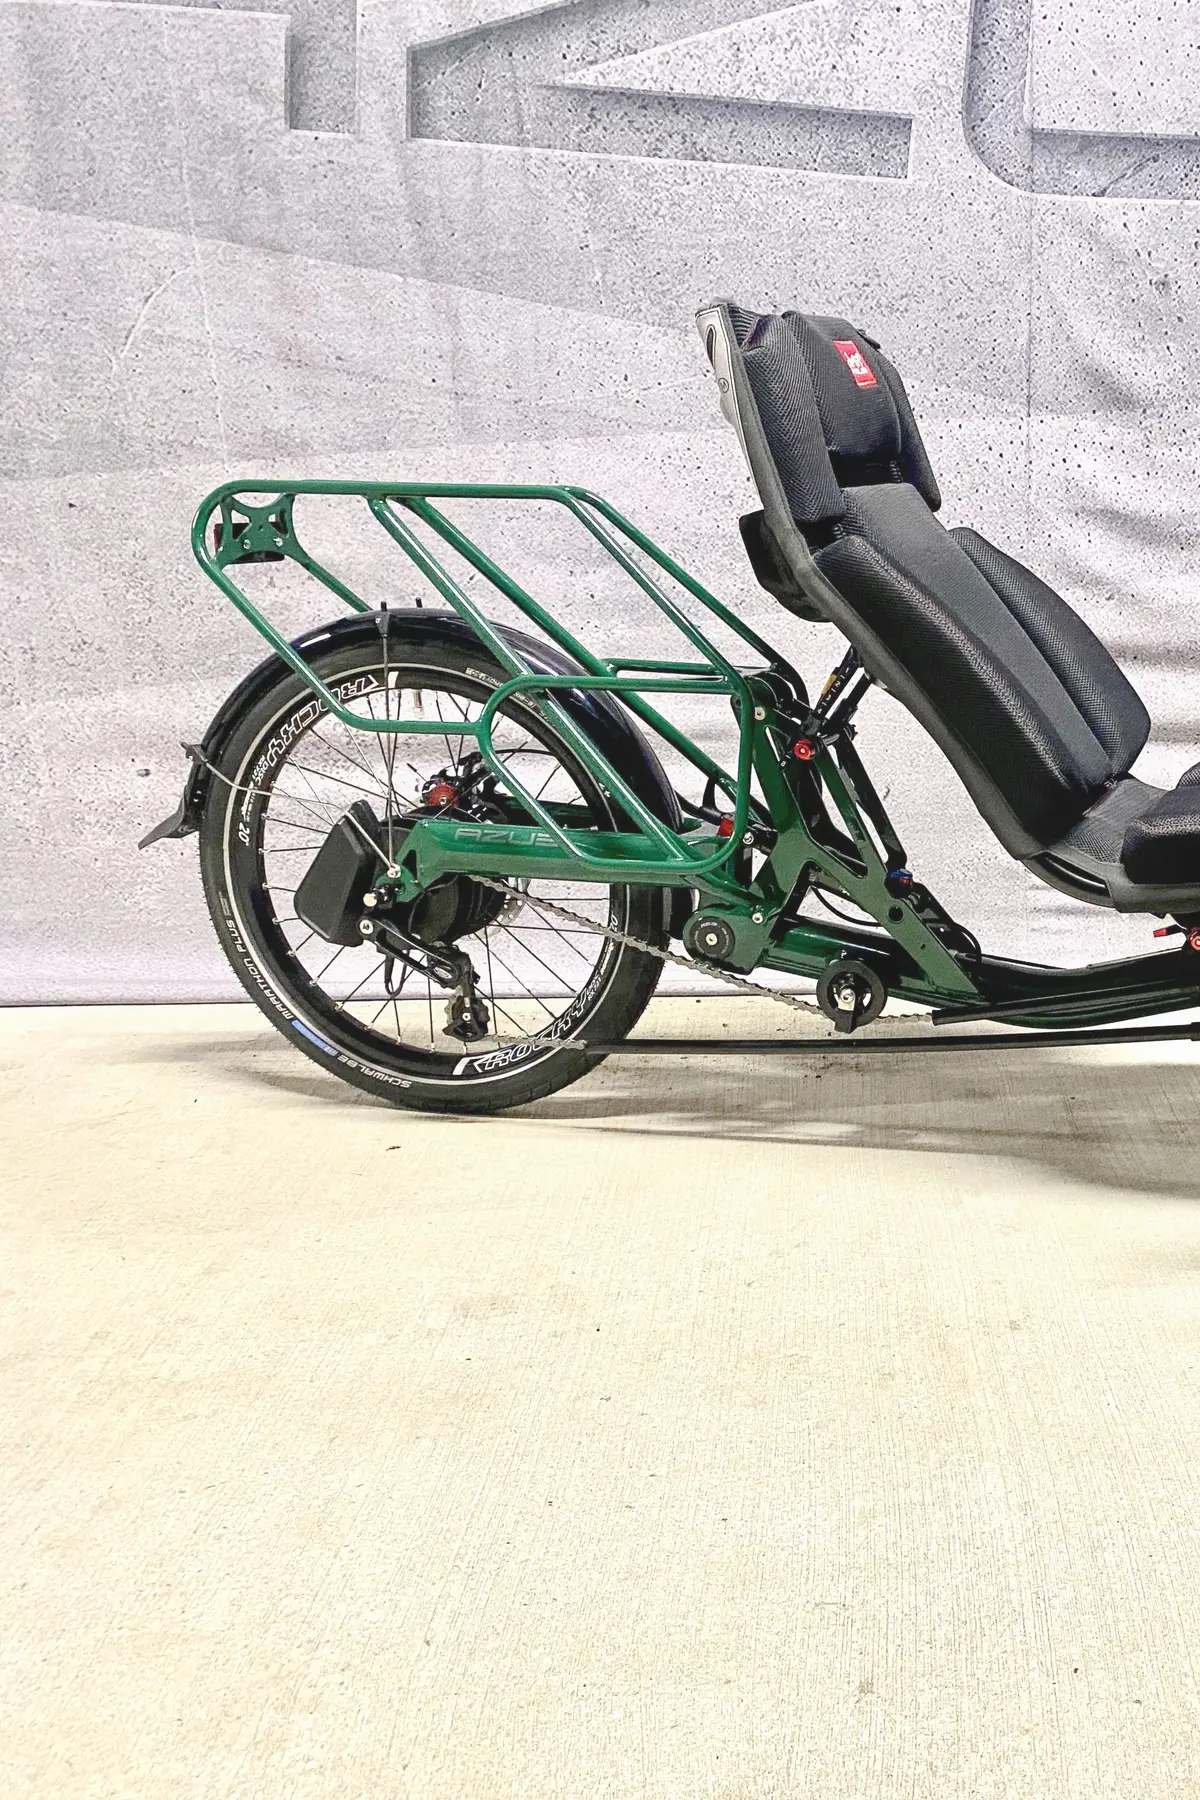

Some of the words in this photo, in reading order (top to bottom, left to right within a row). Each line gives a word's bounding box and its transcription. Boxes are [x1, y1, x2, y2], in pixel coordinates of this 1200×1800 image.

[225, 918, 247, 954] PLUS
[243, 956, 295, 1021] MARATHON
[337, 1053, 412, 1089] SCHWALBE
